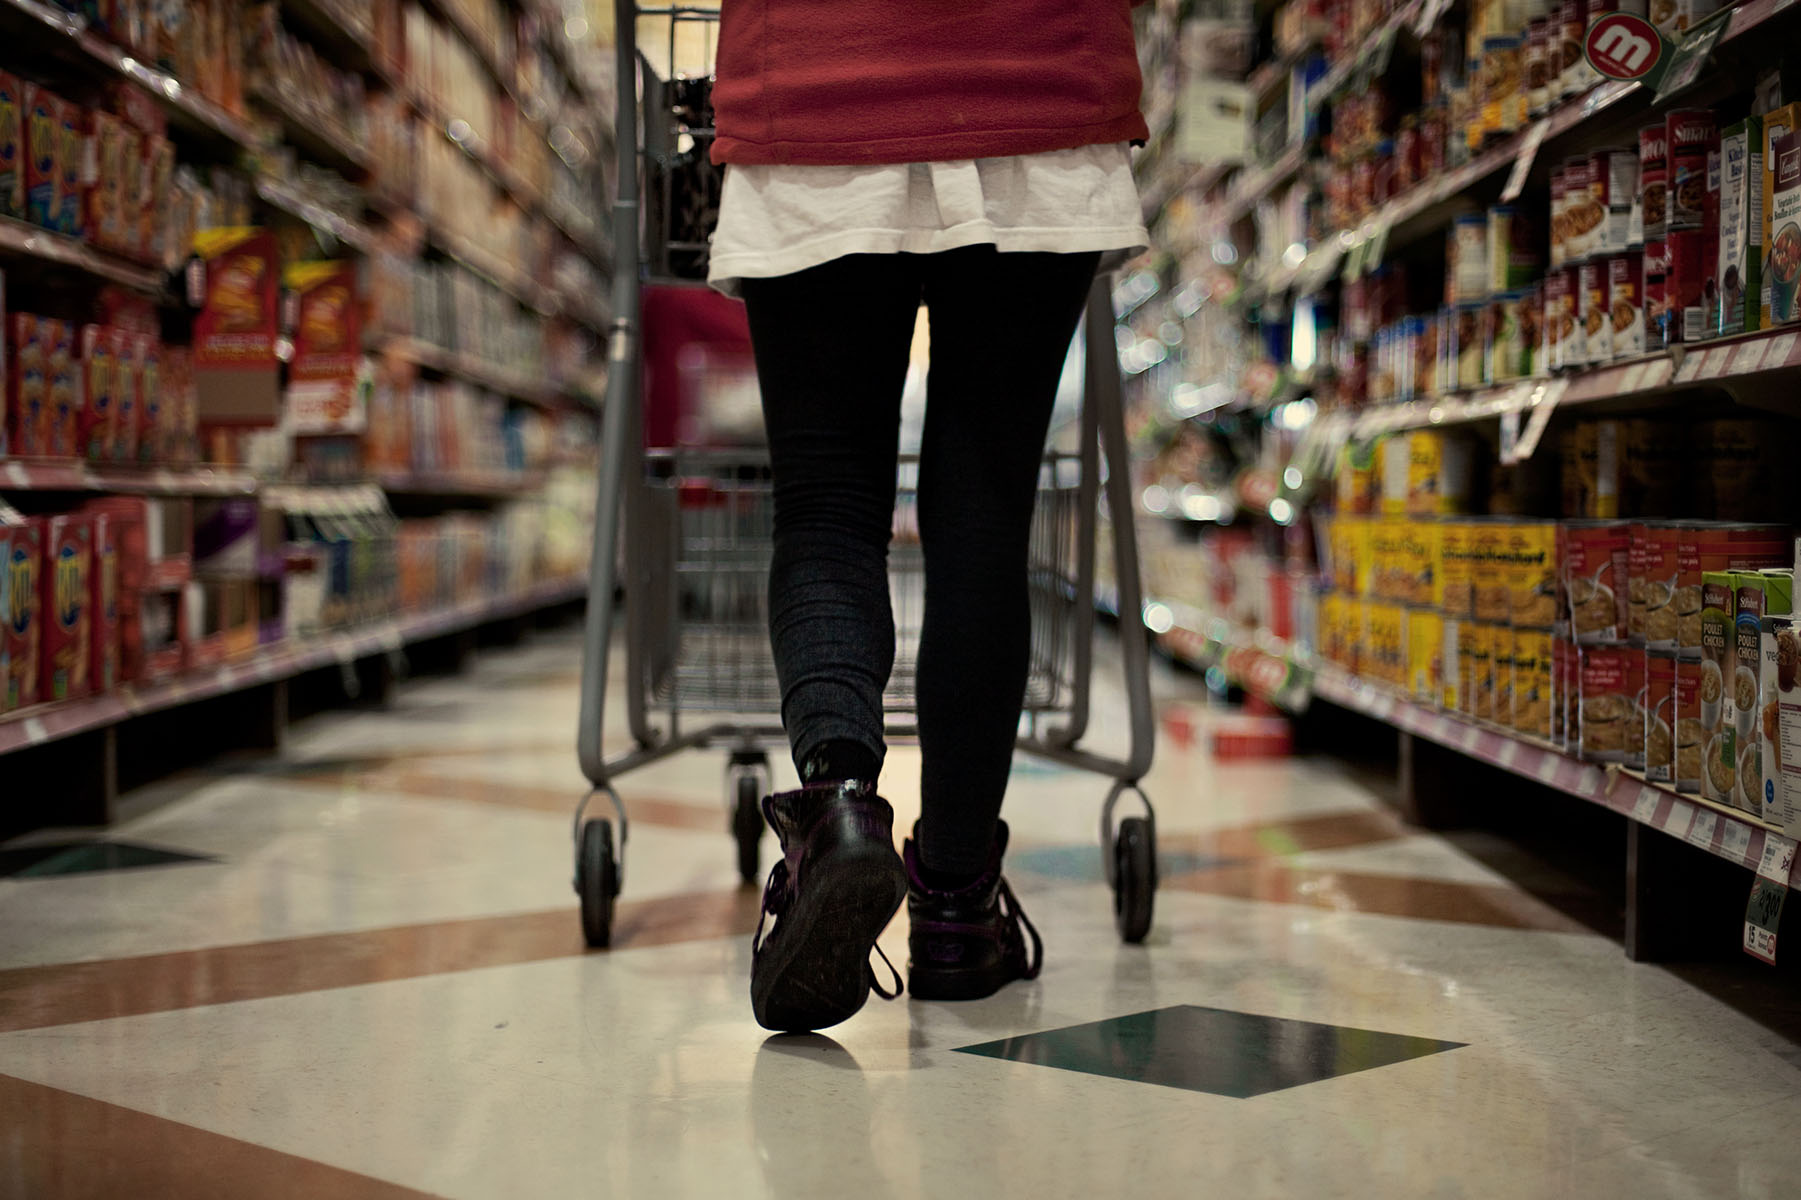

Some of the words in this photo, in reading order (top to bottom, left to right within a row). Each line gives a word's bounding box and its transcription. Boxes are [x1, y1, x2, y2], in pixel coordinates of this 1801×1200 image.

[1593, 24, 1651, 72] m
[1703, 623, 1723, 636] POULET
[1703, 635, 1725, 648] CHICKEN
[1737, 634, 1758, 648] POULET
[1737, 647, 1759, 661] CHICKEN
